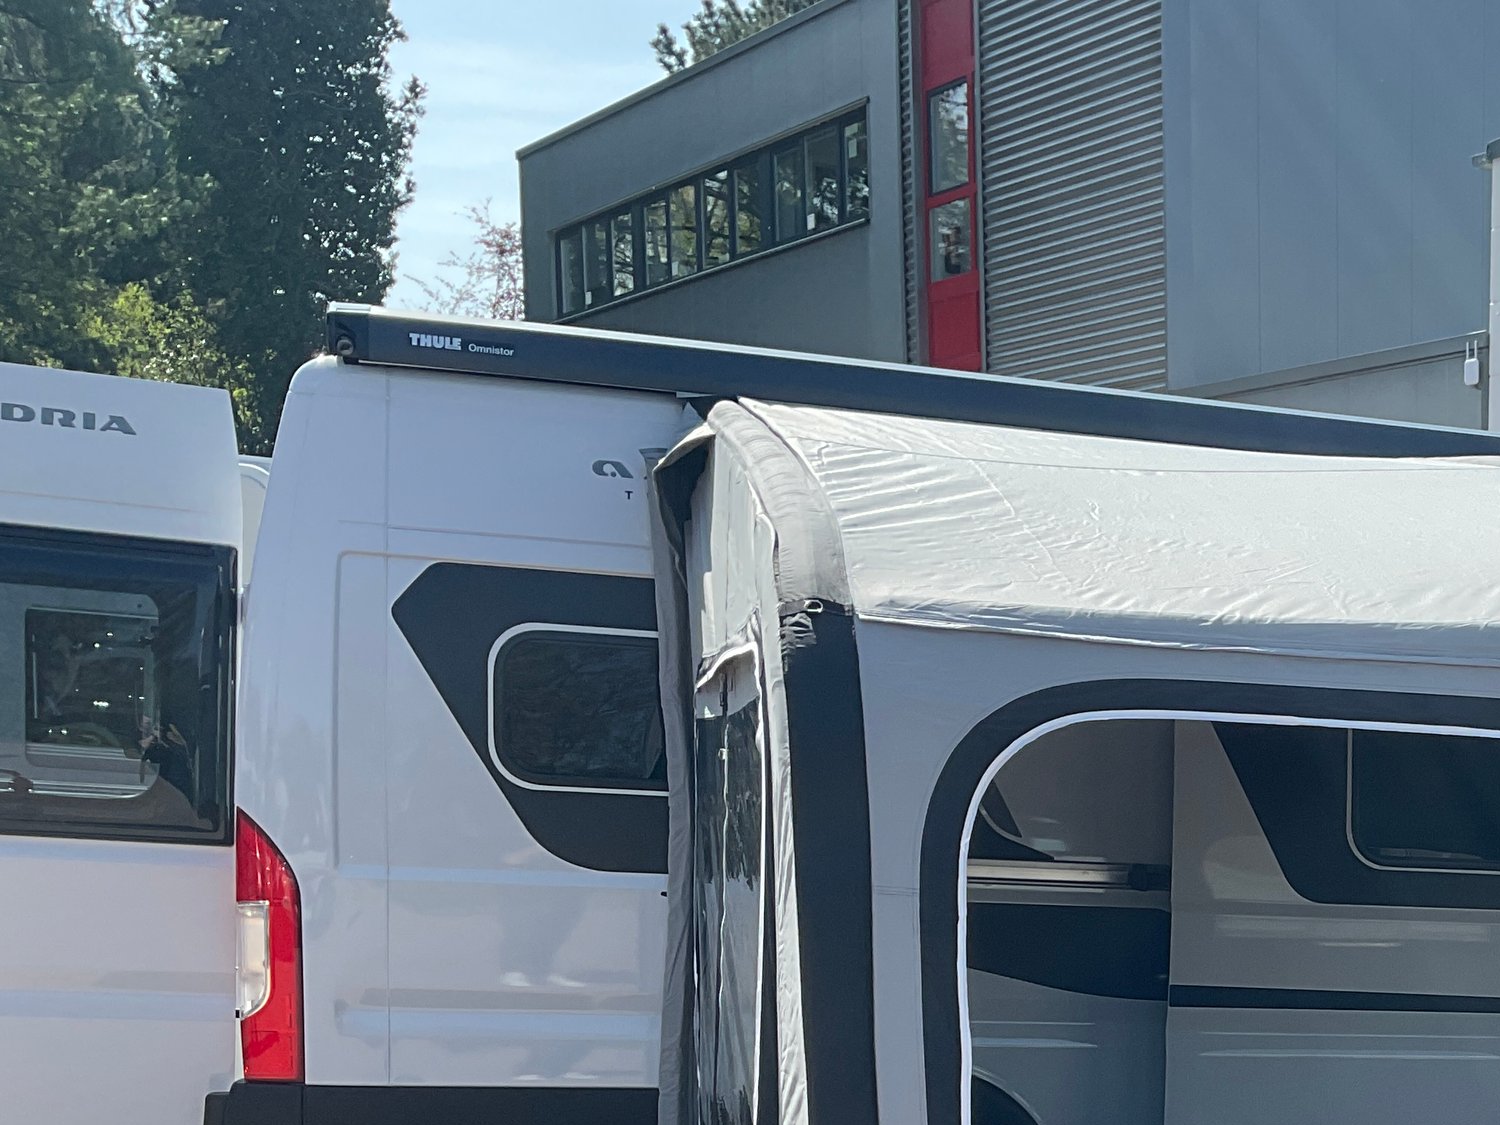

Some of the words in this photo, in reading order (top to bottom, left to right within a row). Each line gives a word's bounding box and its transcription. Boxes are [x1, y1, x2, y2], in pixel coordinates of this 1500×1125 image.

[409, 332, 462, 351] THULE
[468, 343, 514, 356] Omnistor
[0, 402, 137, 435] DRIA
